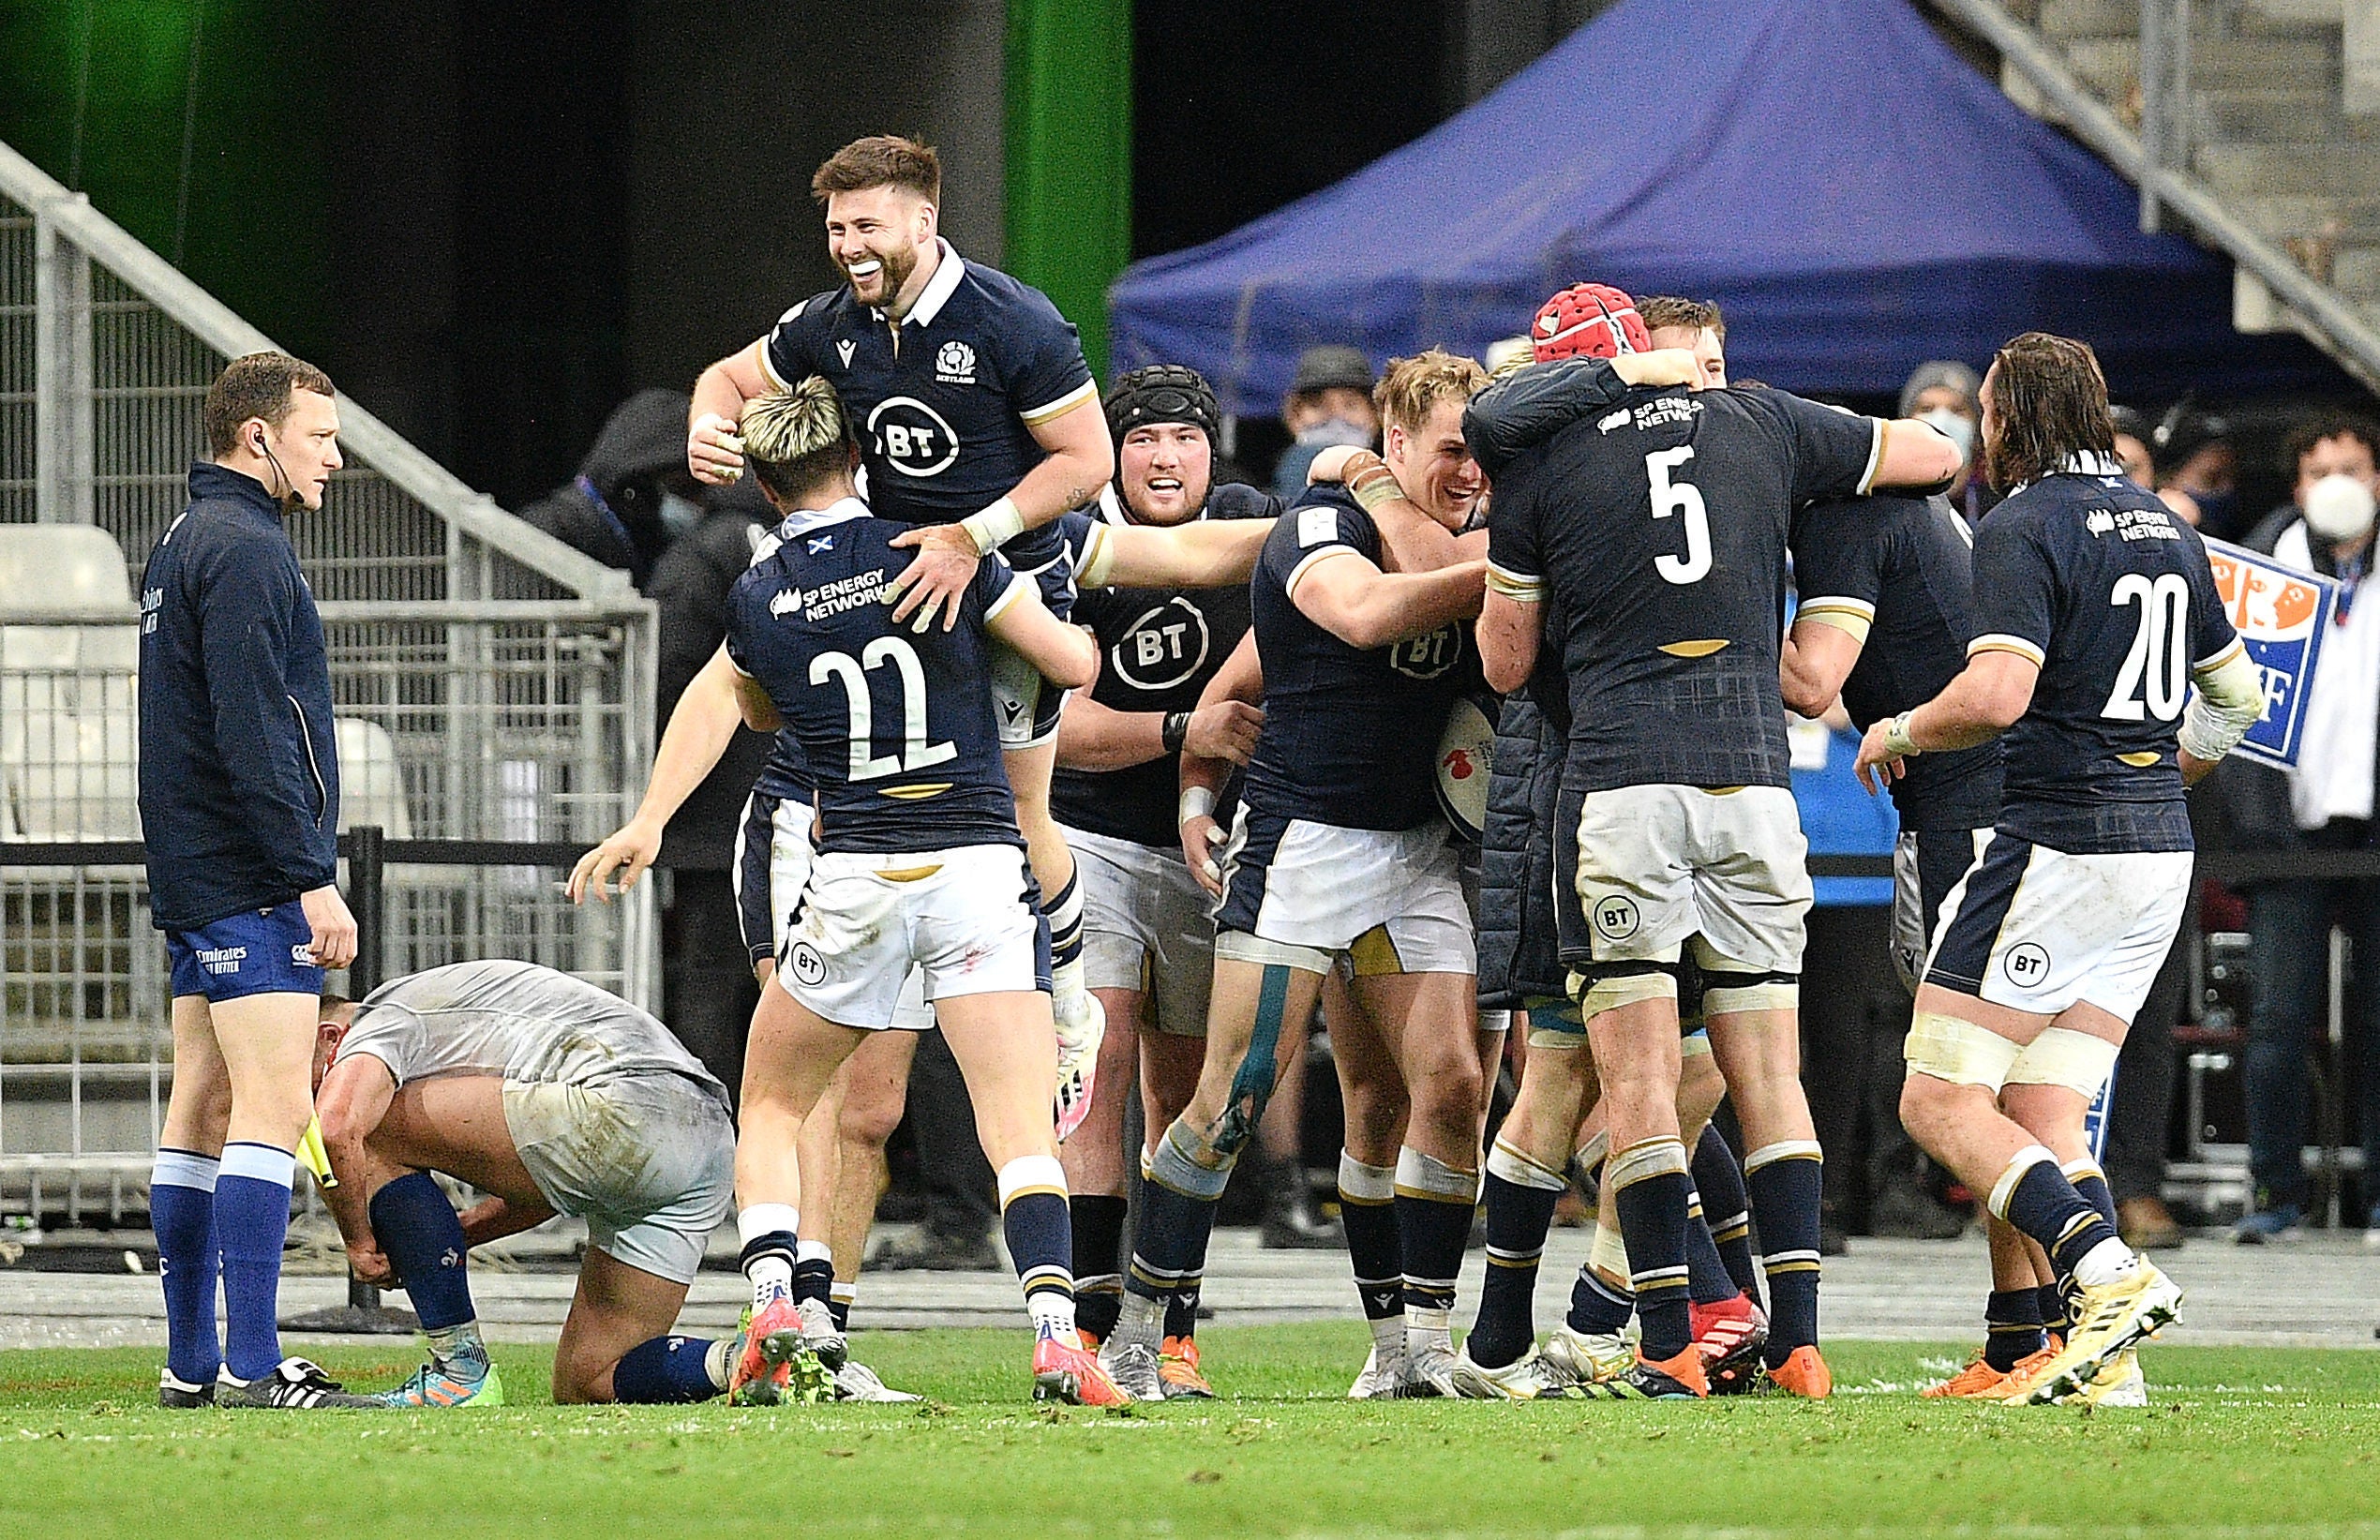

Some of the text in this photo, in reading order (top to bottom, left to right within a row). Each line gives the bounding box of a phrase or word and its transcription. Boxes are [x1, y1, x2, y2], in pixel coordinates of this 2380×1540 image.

[1634, 402, 1654, 419] SP
[886, 425, 935, 458] BT
[1645, 444, 1713, 585] 5
[2114, 511, 2134, 528] SP
[802, 568, 885, 607] SP ENERGY
[1136, 622, 1187, 666] BT
[1409, 631, 1448, 665] BT
[2100, 573, 2190, 722] 20
[809, 636, 958, 782] 22
[1604, 907, 1629, 927] BT
[195, 946, 247, 964] Emirates
[799, 951, 818, 974] BT
[2014, 954, 2042, 975] BT
